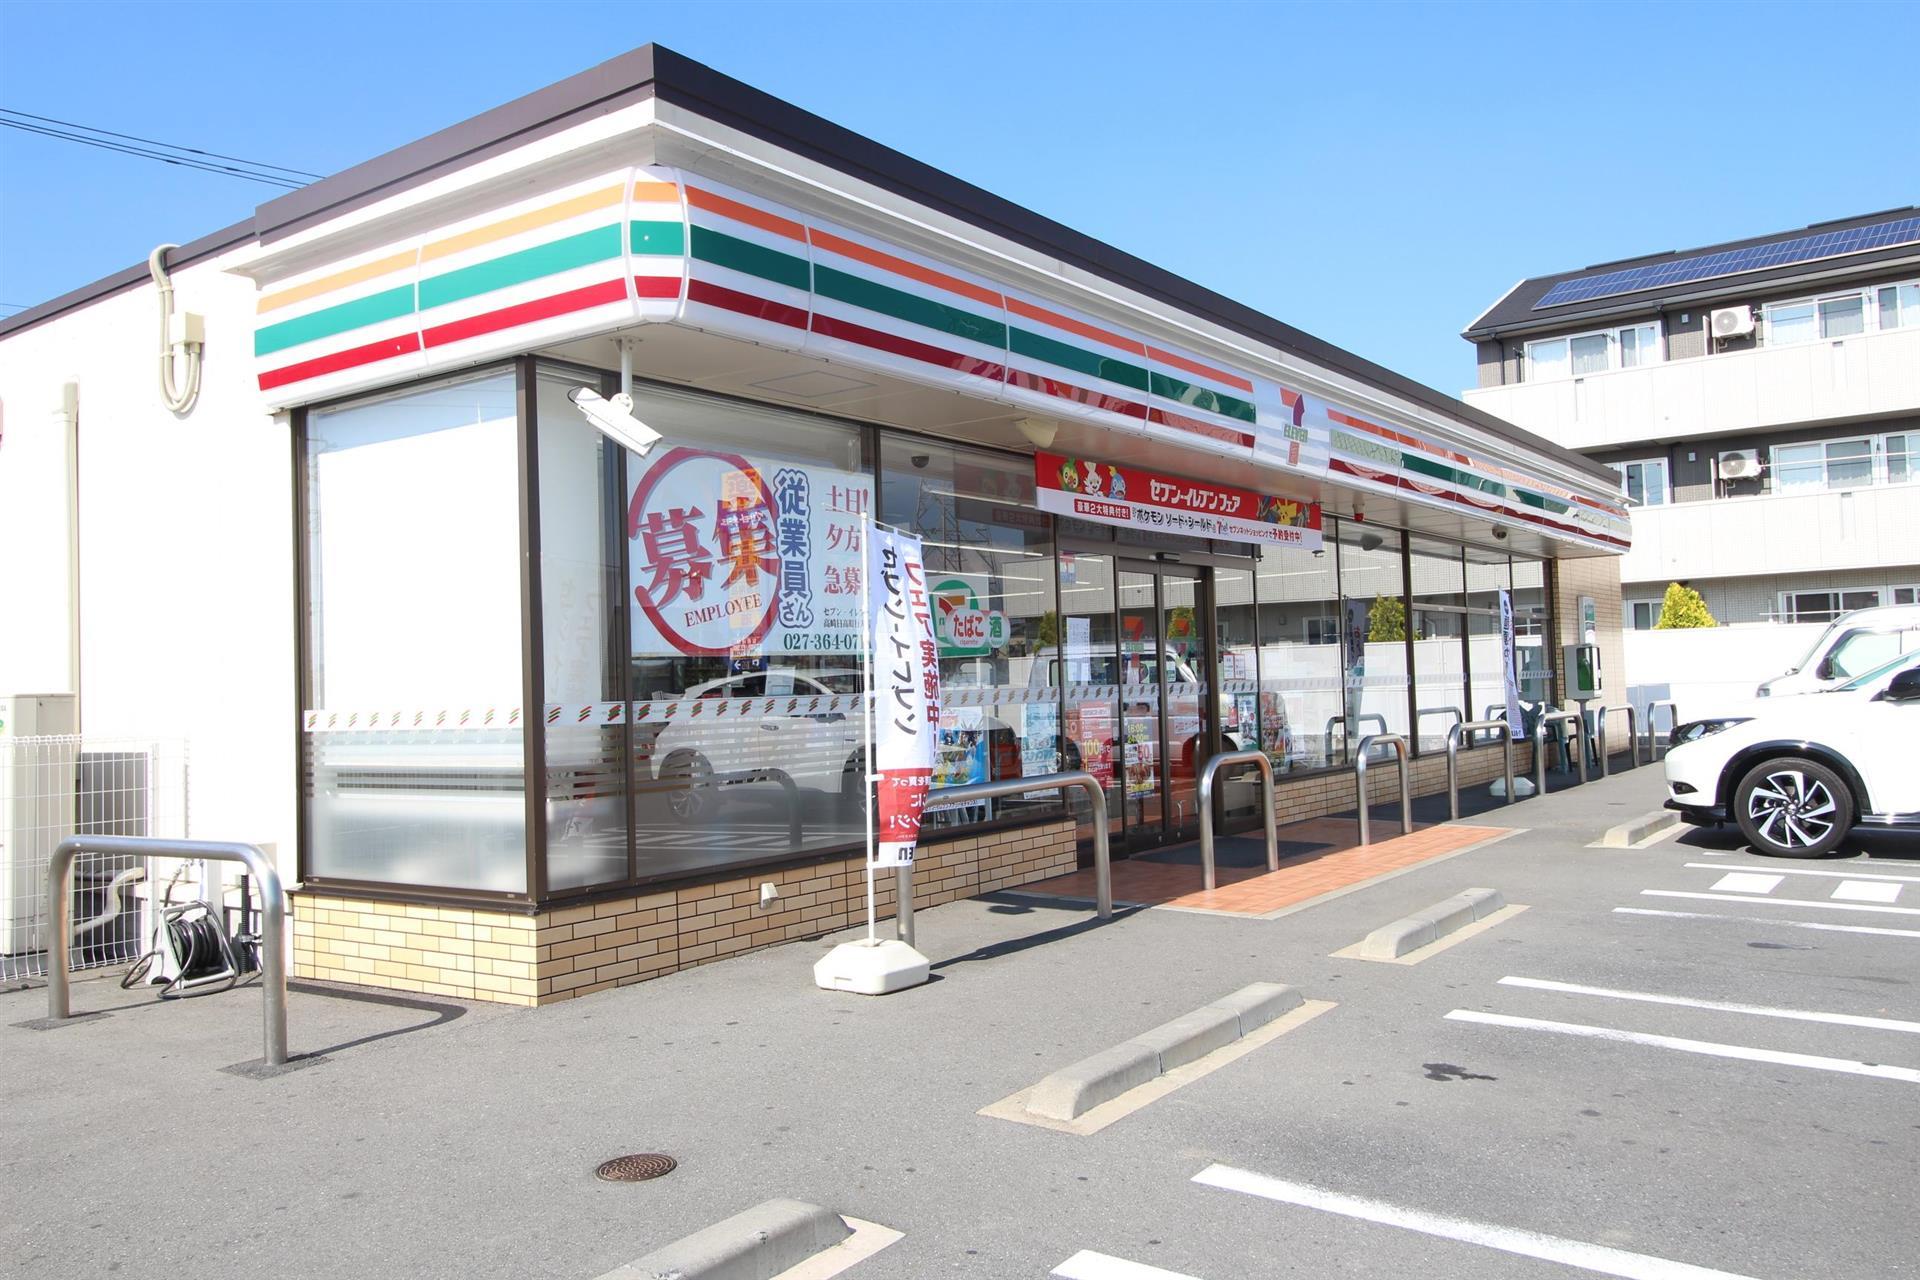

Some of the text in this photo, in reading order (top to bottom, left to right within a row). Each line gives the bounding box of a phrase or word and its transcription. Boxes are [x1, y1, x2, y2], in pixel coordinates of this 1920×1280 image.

[825, 484, 869, 515] 土日!
[639, 497, 778, 611] 募集
[777, 474, 811, 624] 従業員さん
[825, 523, 869, 553] 夕方
[824, 564, 861, 597] 急募
[684, 593, 763, 628] EMPLOYEE
[953, 614, 1003, 638] たばこ 酒
[784, 633, 872, 650] 027-364-07
